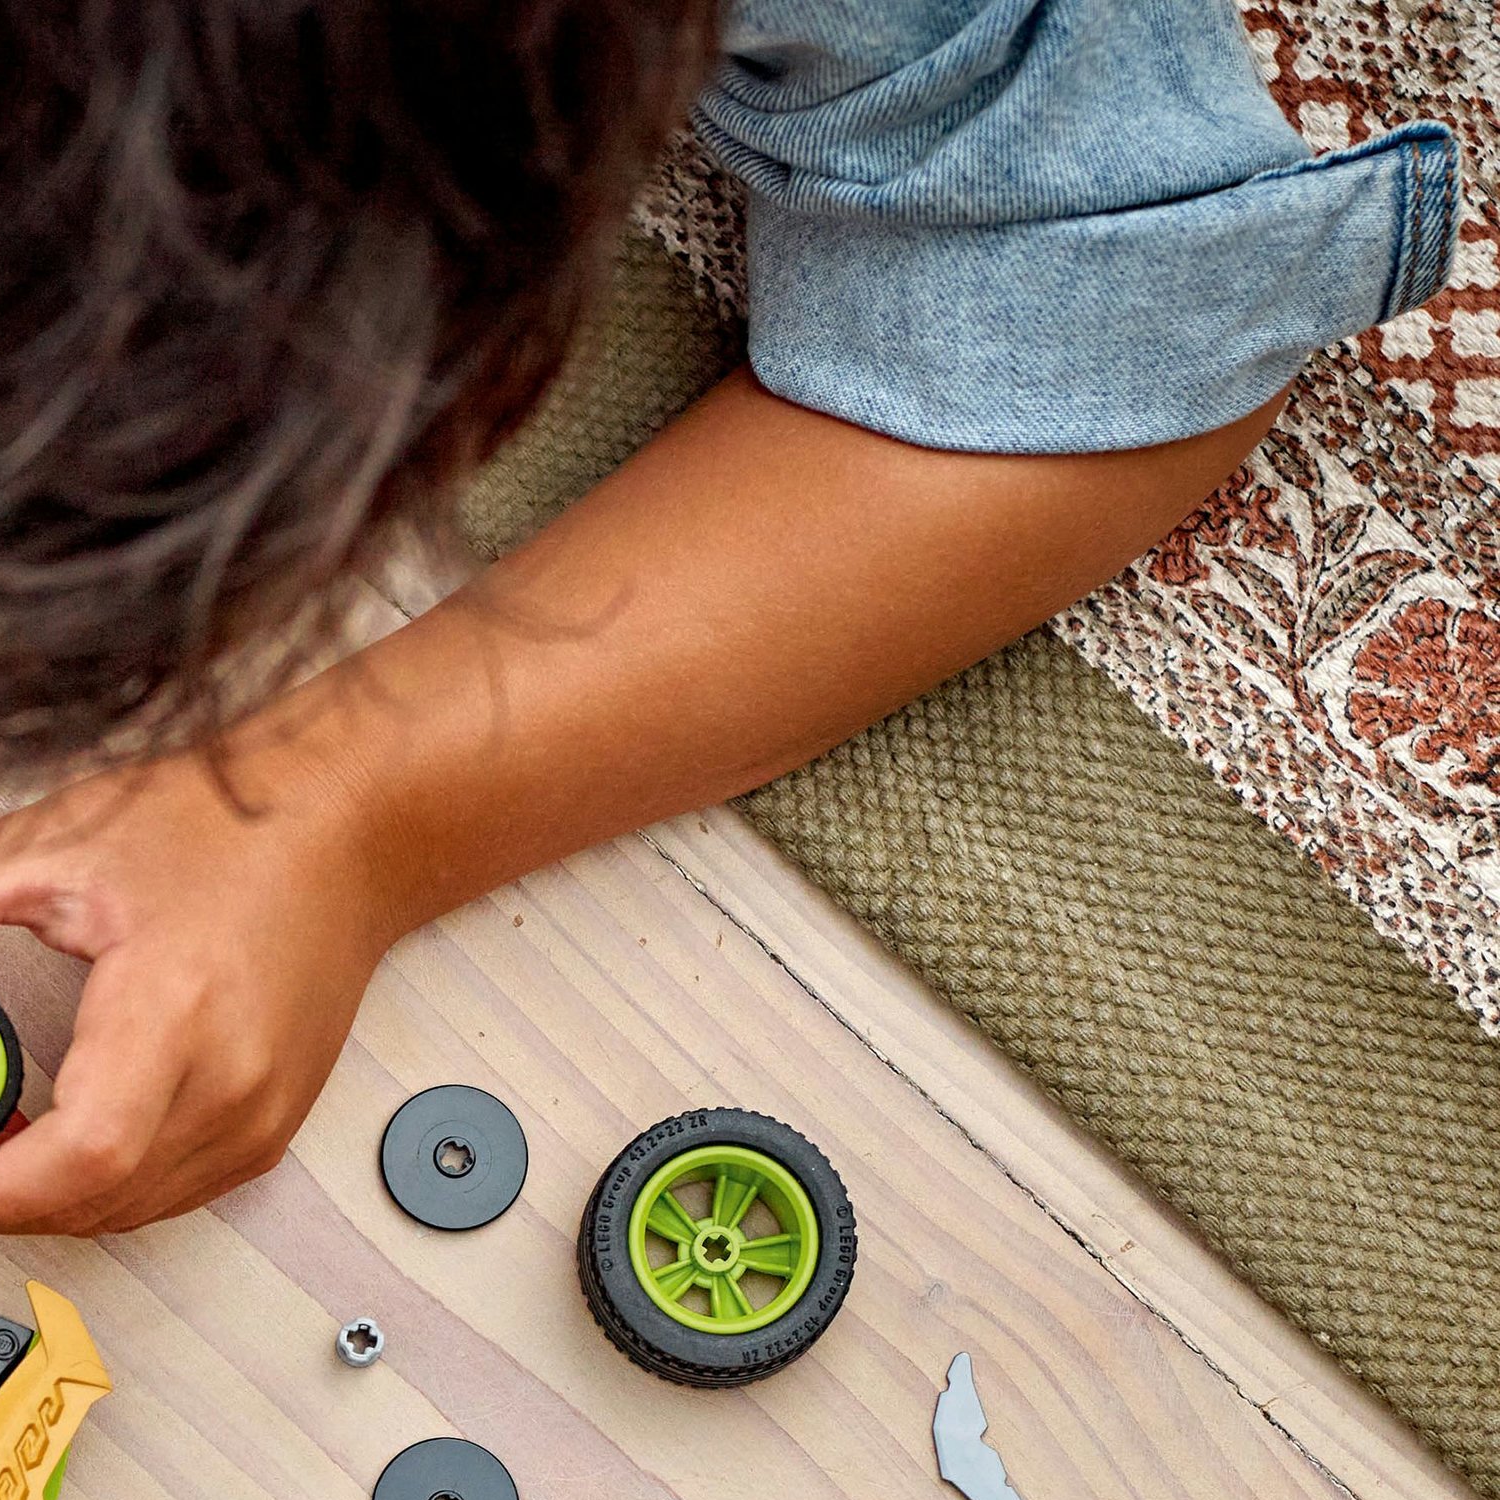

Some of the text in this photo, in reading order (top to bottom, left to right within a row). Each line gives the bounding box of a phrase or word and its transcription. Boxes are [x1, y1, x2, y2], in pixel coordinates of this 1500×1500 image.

[688, 1114, 708, 1128] ZR
[602, 1166, 632, 1209] Group
[598, 1215, 611, 1252] LEGO
[839, 1225, 852, 1263] LEGO
[819, 1268, 847, 1312] Group
